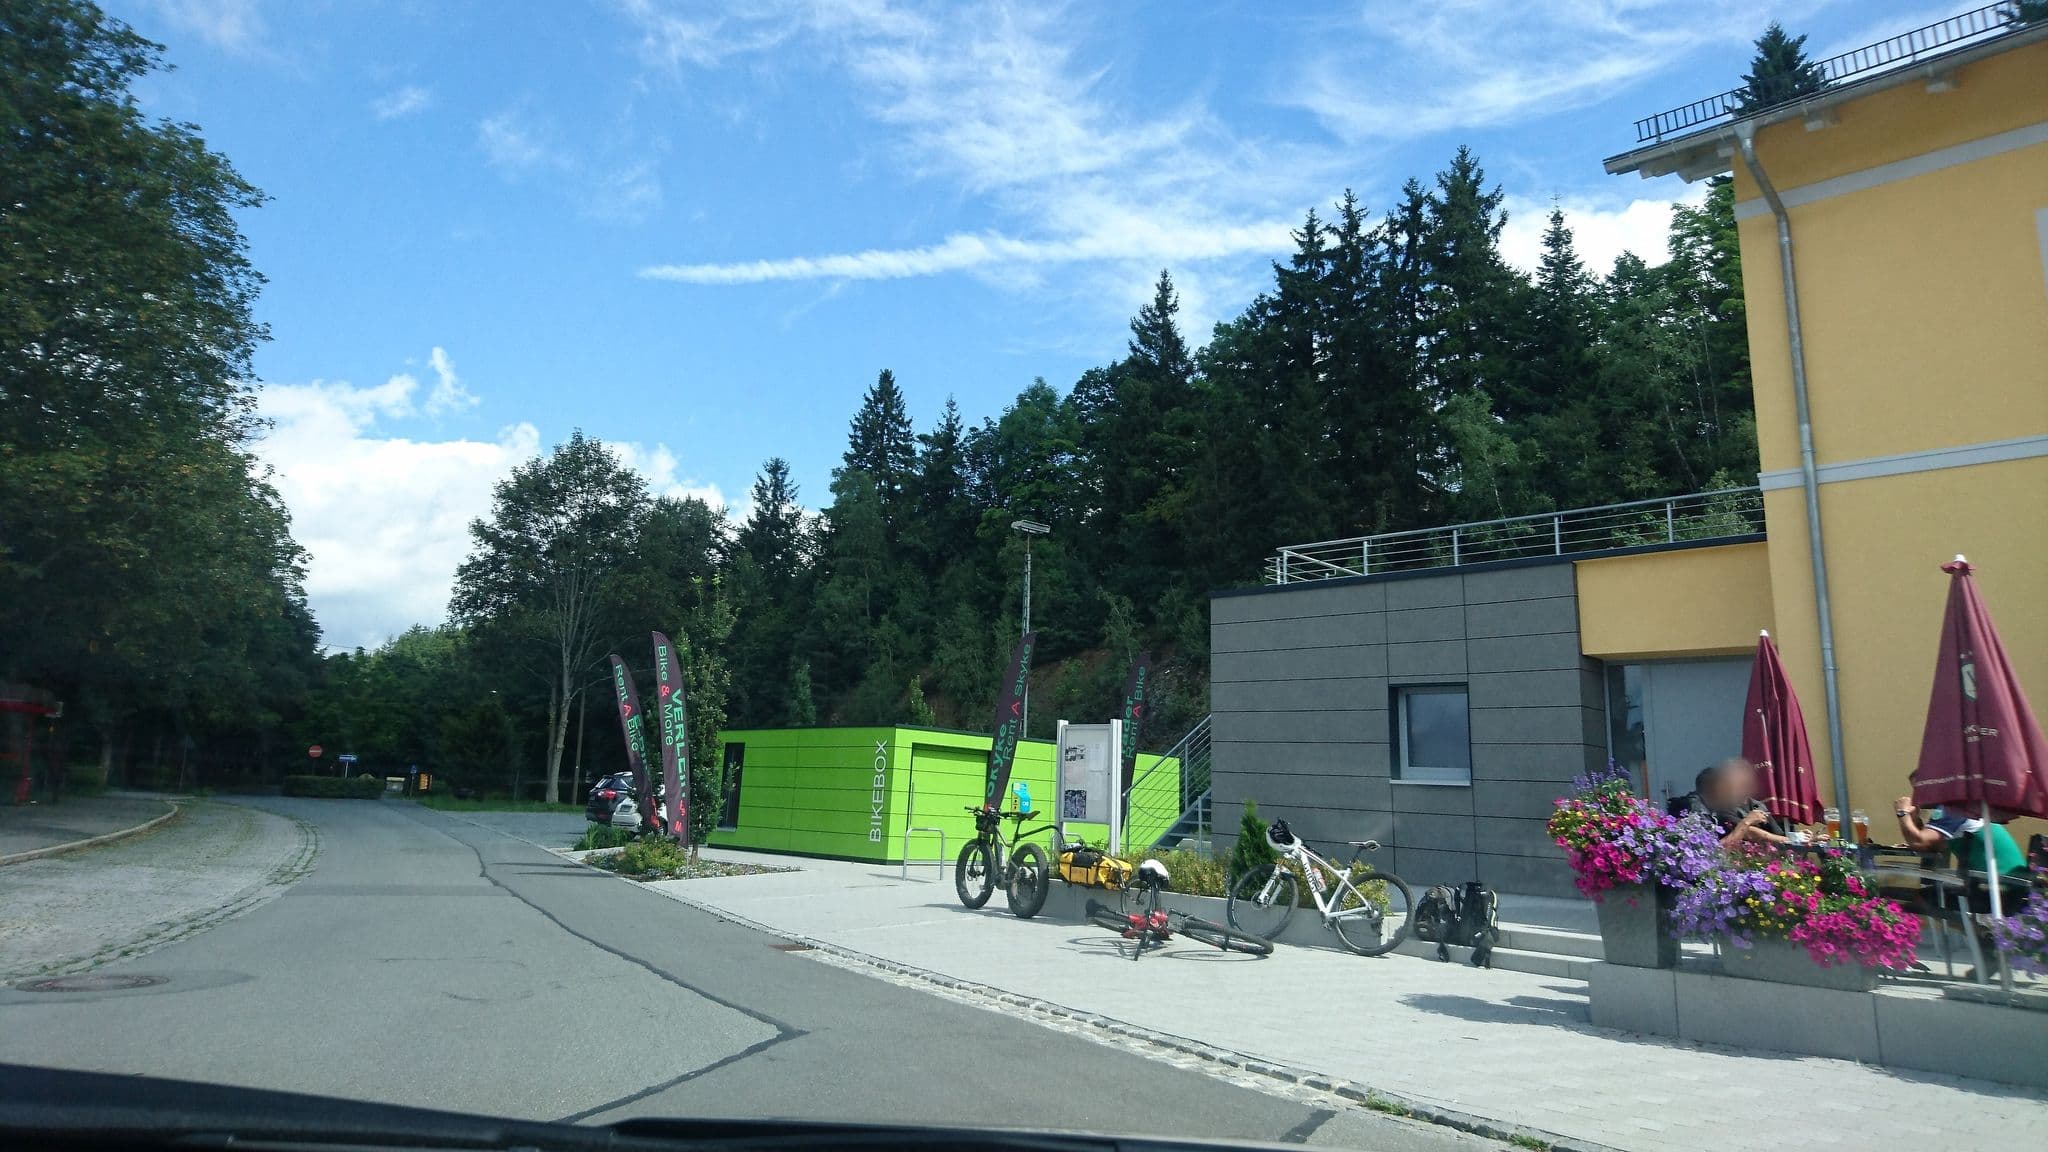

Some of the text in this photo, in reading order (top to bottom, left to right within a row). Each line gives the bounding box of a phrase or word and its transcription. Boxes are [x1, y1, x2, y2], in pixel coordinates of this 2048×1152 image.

[615, 664, 640, 752] Rent A Bike
[658, 645, 674, 746] Bike & More
[1002, 643, 1031, 761] Rent A Skyke
[1126, 666, 1146, 759] Rent A Bike
[869, 740, 888, 843] BIKEBOX
